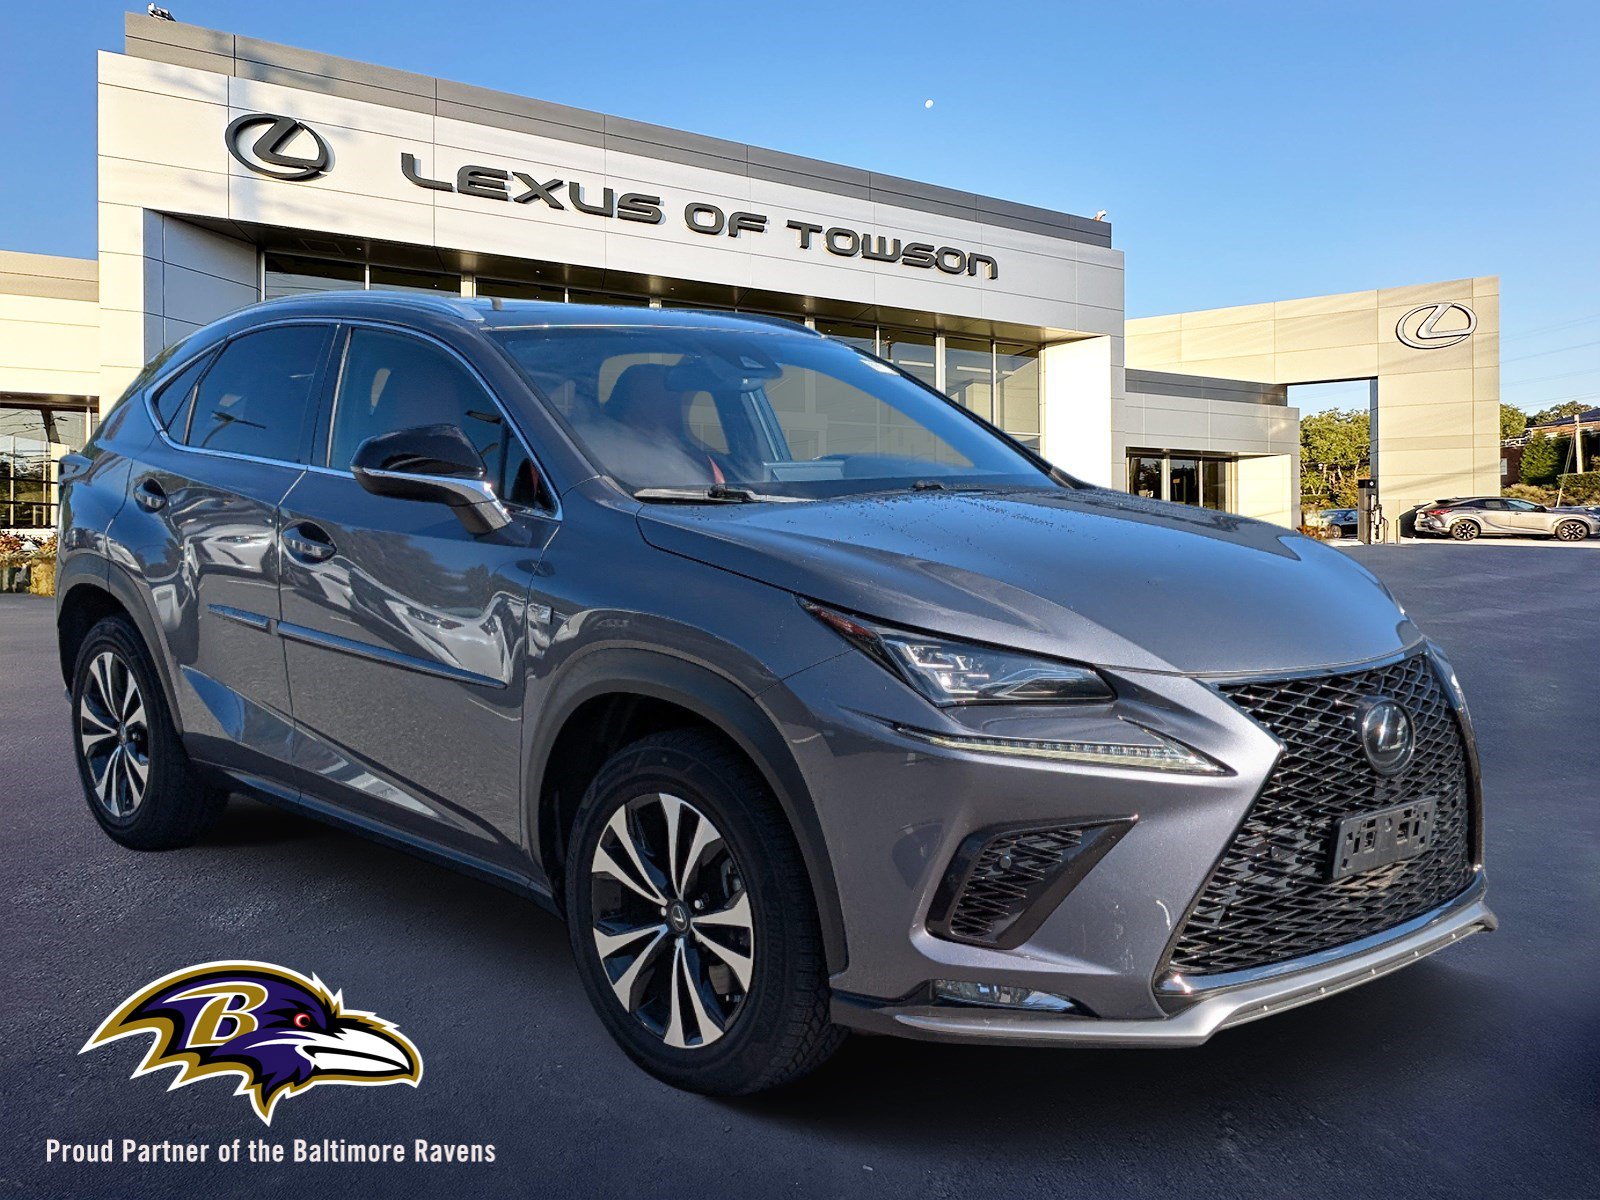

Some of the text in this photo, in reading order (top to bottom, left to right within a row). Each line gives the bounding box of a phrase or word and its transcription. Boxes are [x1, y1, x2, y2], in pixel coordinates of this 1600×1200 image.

[401, 152, 999, 281] LEXUS OF TOWSON
